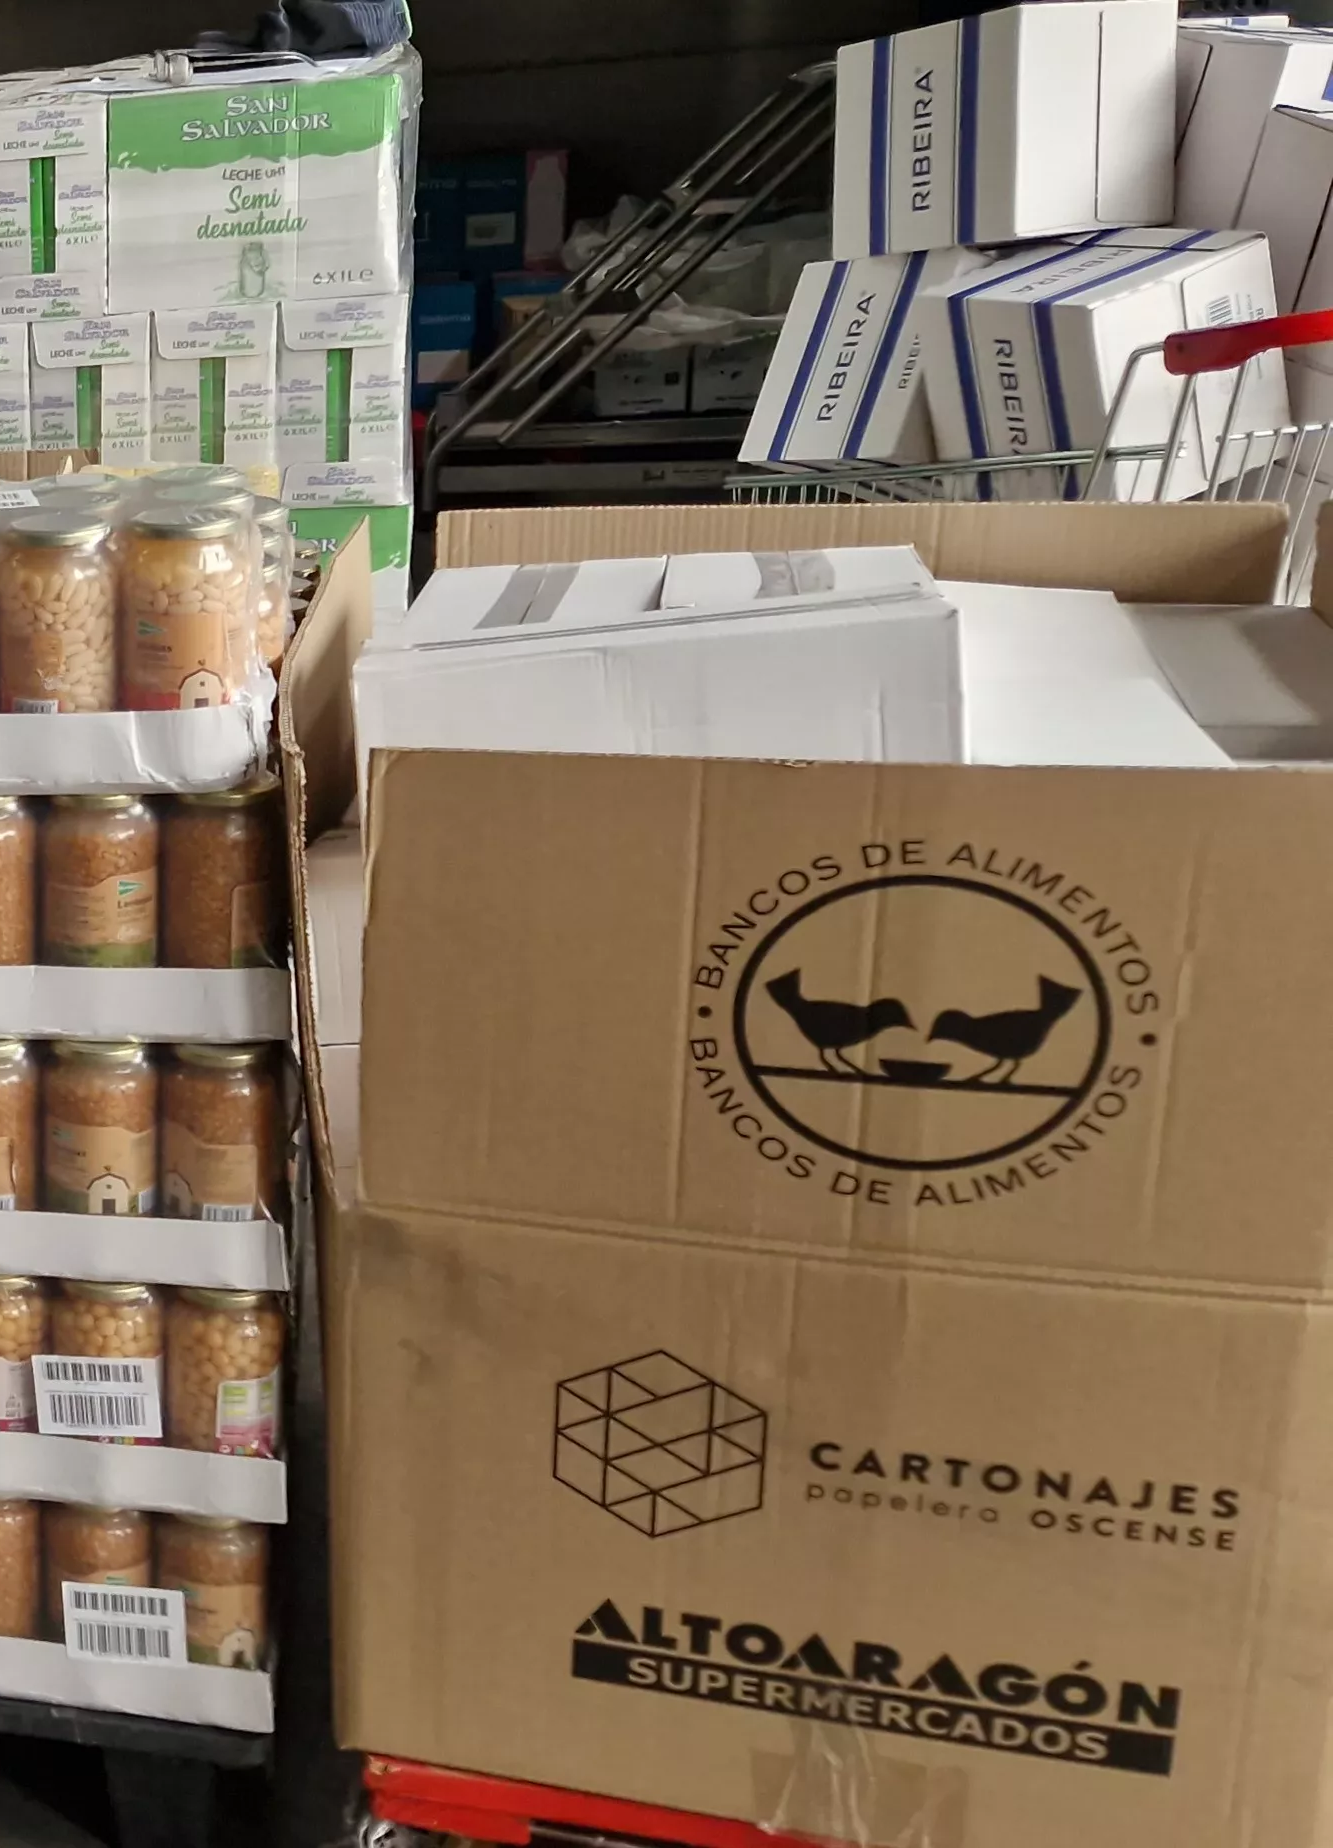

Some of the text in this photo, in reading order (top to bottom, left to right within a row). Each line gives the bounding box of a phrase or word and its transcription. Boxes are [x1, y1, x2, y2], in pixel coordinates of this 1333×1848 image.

[180, 112, 330, 142] SALVADOR
[225, 96, 287, 116] SAN
[911, 69, 934, 212] RIBEIRA
[222, 168, 261, 181] LECHE
[224, 185, 282, 214] Semi
[196, 217, 309, 240] desnatada
[816, 293, 873, 423] RIBEIRA
[994, 339, 1028, 454] RIBEIR
[692, 839, 1161, 1017] BANCOS DE ALIMENTOS
[688, 1034, 1142, 1210] BANCOS DE ALIMENTOS
[806, 1483, 1237, 1552] papelera OSCENSE
[808, 1441, 1241, 1520] CARTONAJES
[575, 1599, 1182, 1728] ALTOARAGÓN
[626, 1655, 1110, 1761] SUPERMERCADOS
